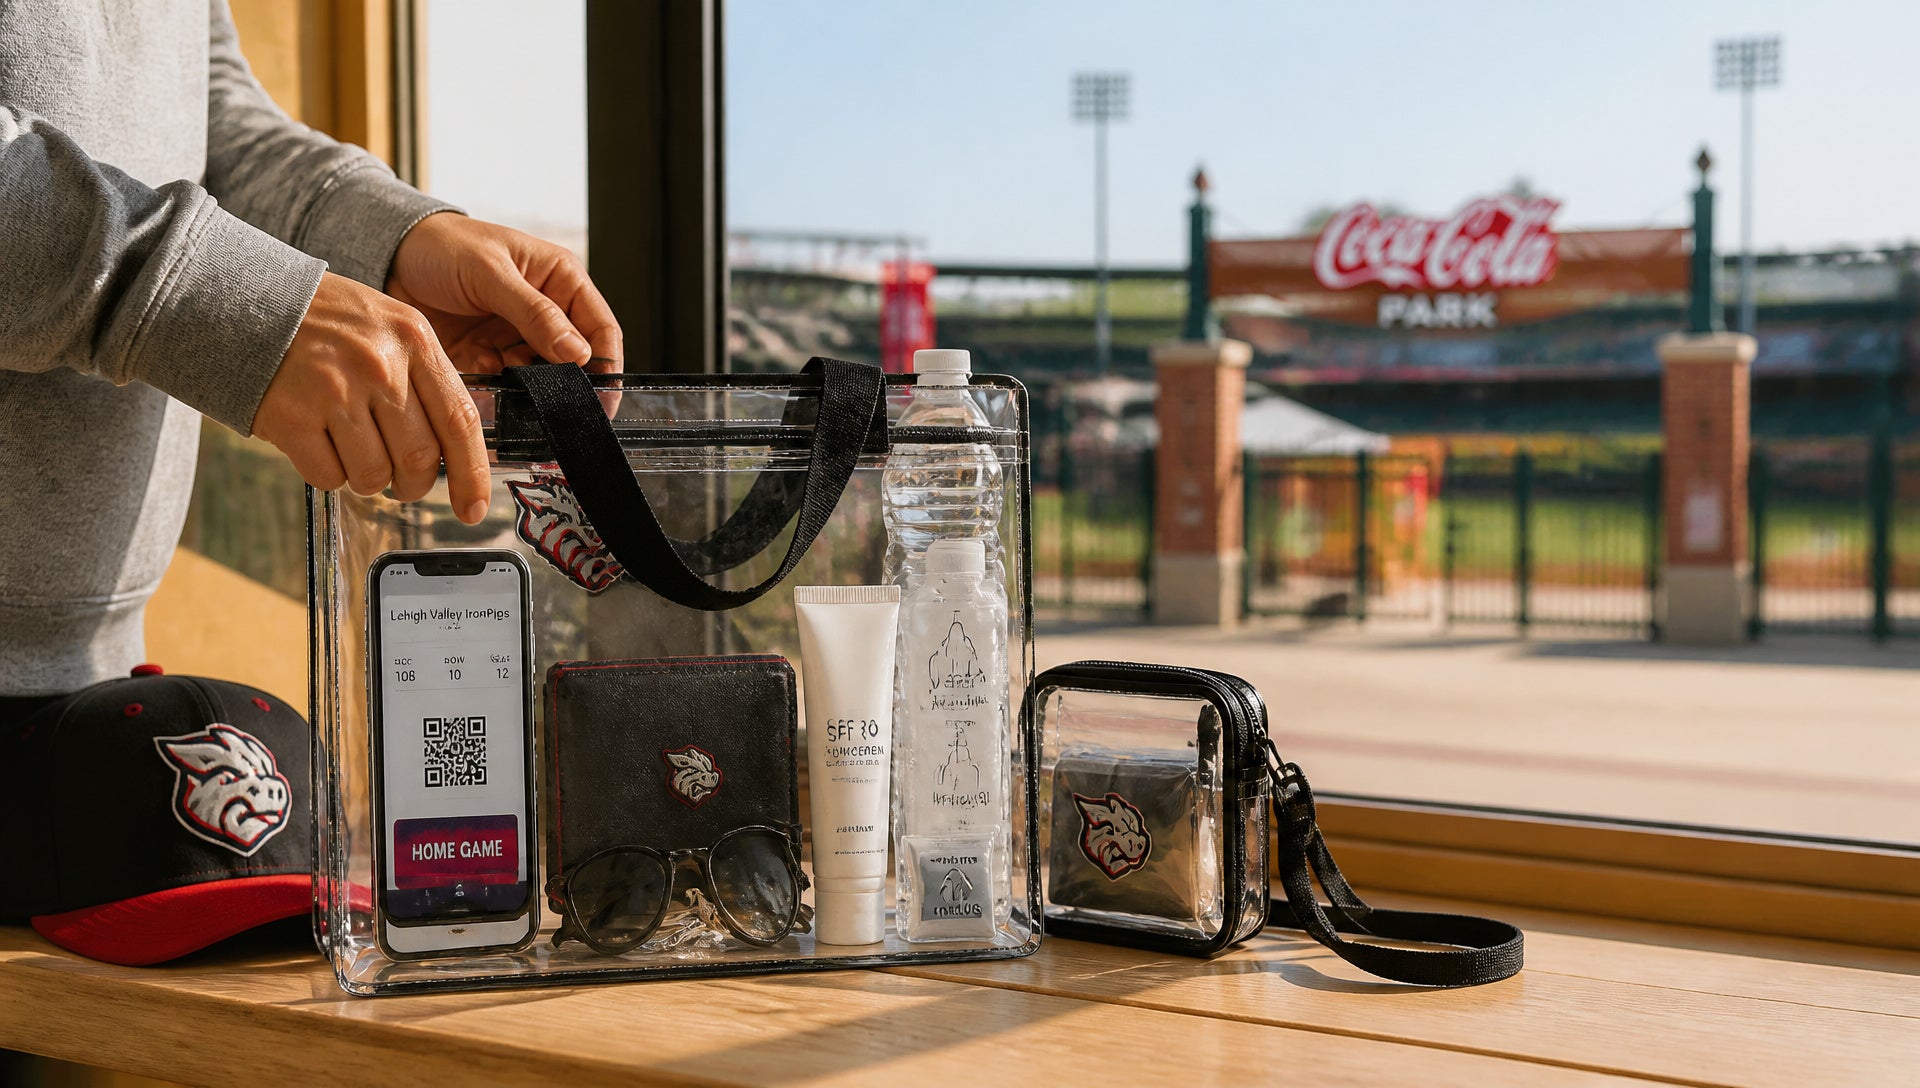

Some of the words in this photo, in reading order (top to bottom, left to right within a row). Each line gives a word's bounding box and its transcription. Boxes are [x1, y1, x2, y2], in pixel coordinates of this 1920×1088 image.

[1377, 292, 1498, 329] PARK
[390, 608, 427, 624] Lehigh
[429, 607, 463, 623] Valley
[465, 608, 510, 621] IronPigs
[395, 670, 416, 681] 108
[449, 669, 462, 680] 10
[496, 667, 509, 679] 12
[412, 841, 456, 861] HOME
[460, 839, 503, 859] GAME
